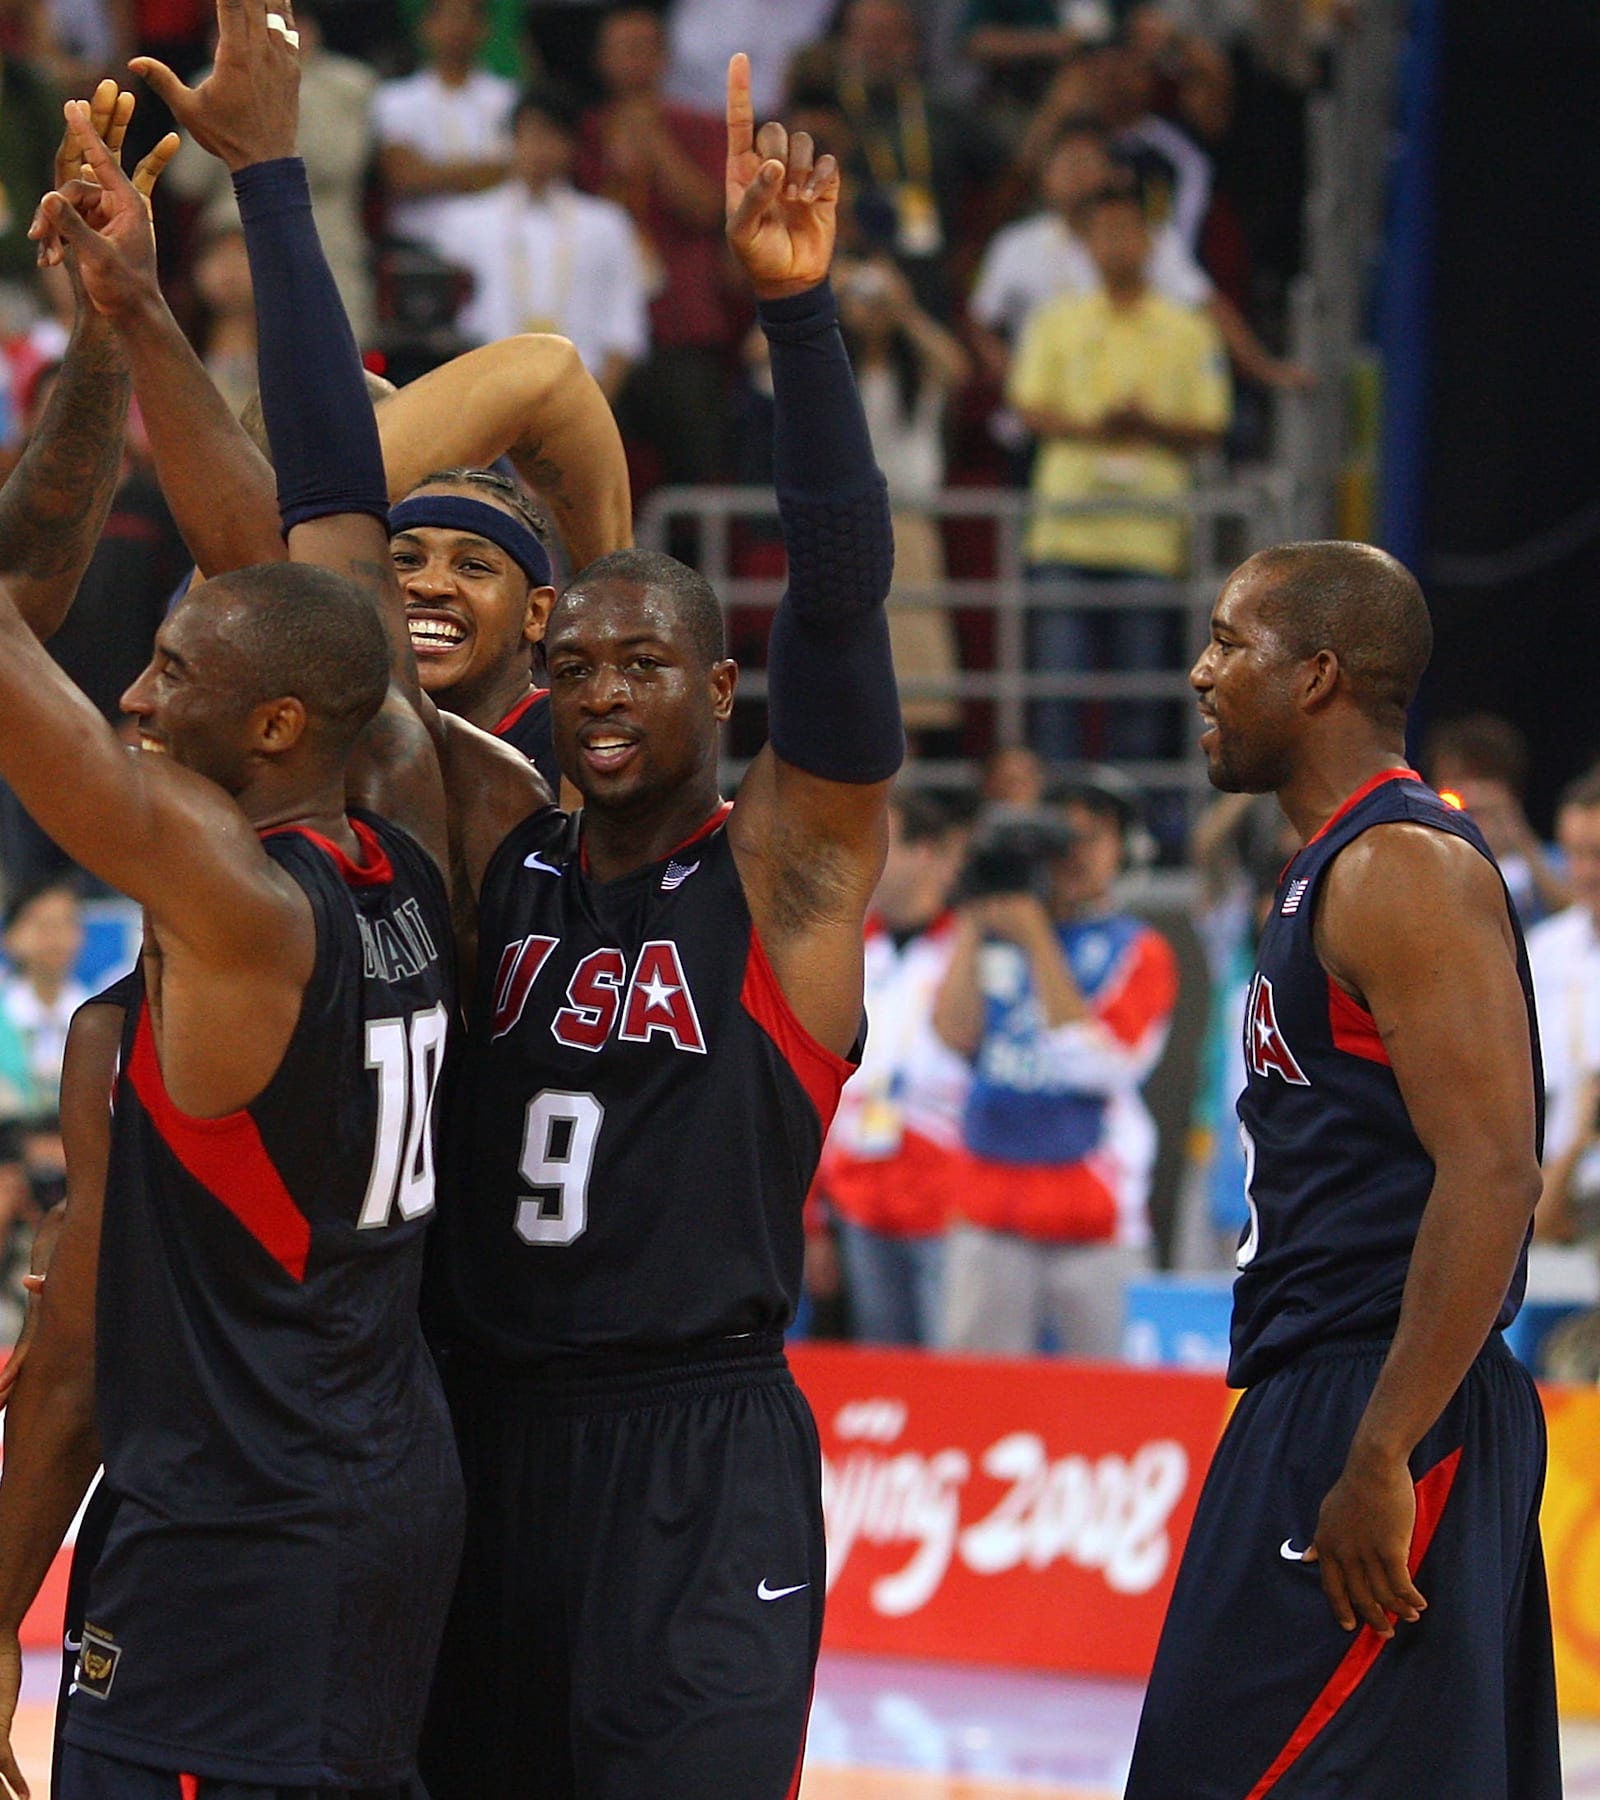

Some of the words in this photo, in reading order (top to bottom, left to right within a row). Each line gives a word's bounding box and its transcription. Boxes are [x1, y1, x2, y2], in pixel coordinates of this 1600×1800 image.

[491, 934, 708, 1055] USA
[356, 999, 449, 1230] 10
[512, 1087, 606, 1247] 9
[958, 1411, 1190, 1597] 2008
